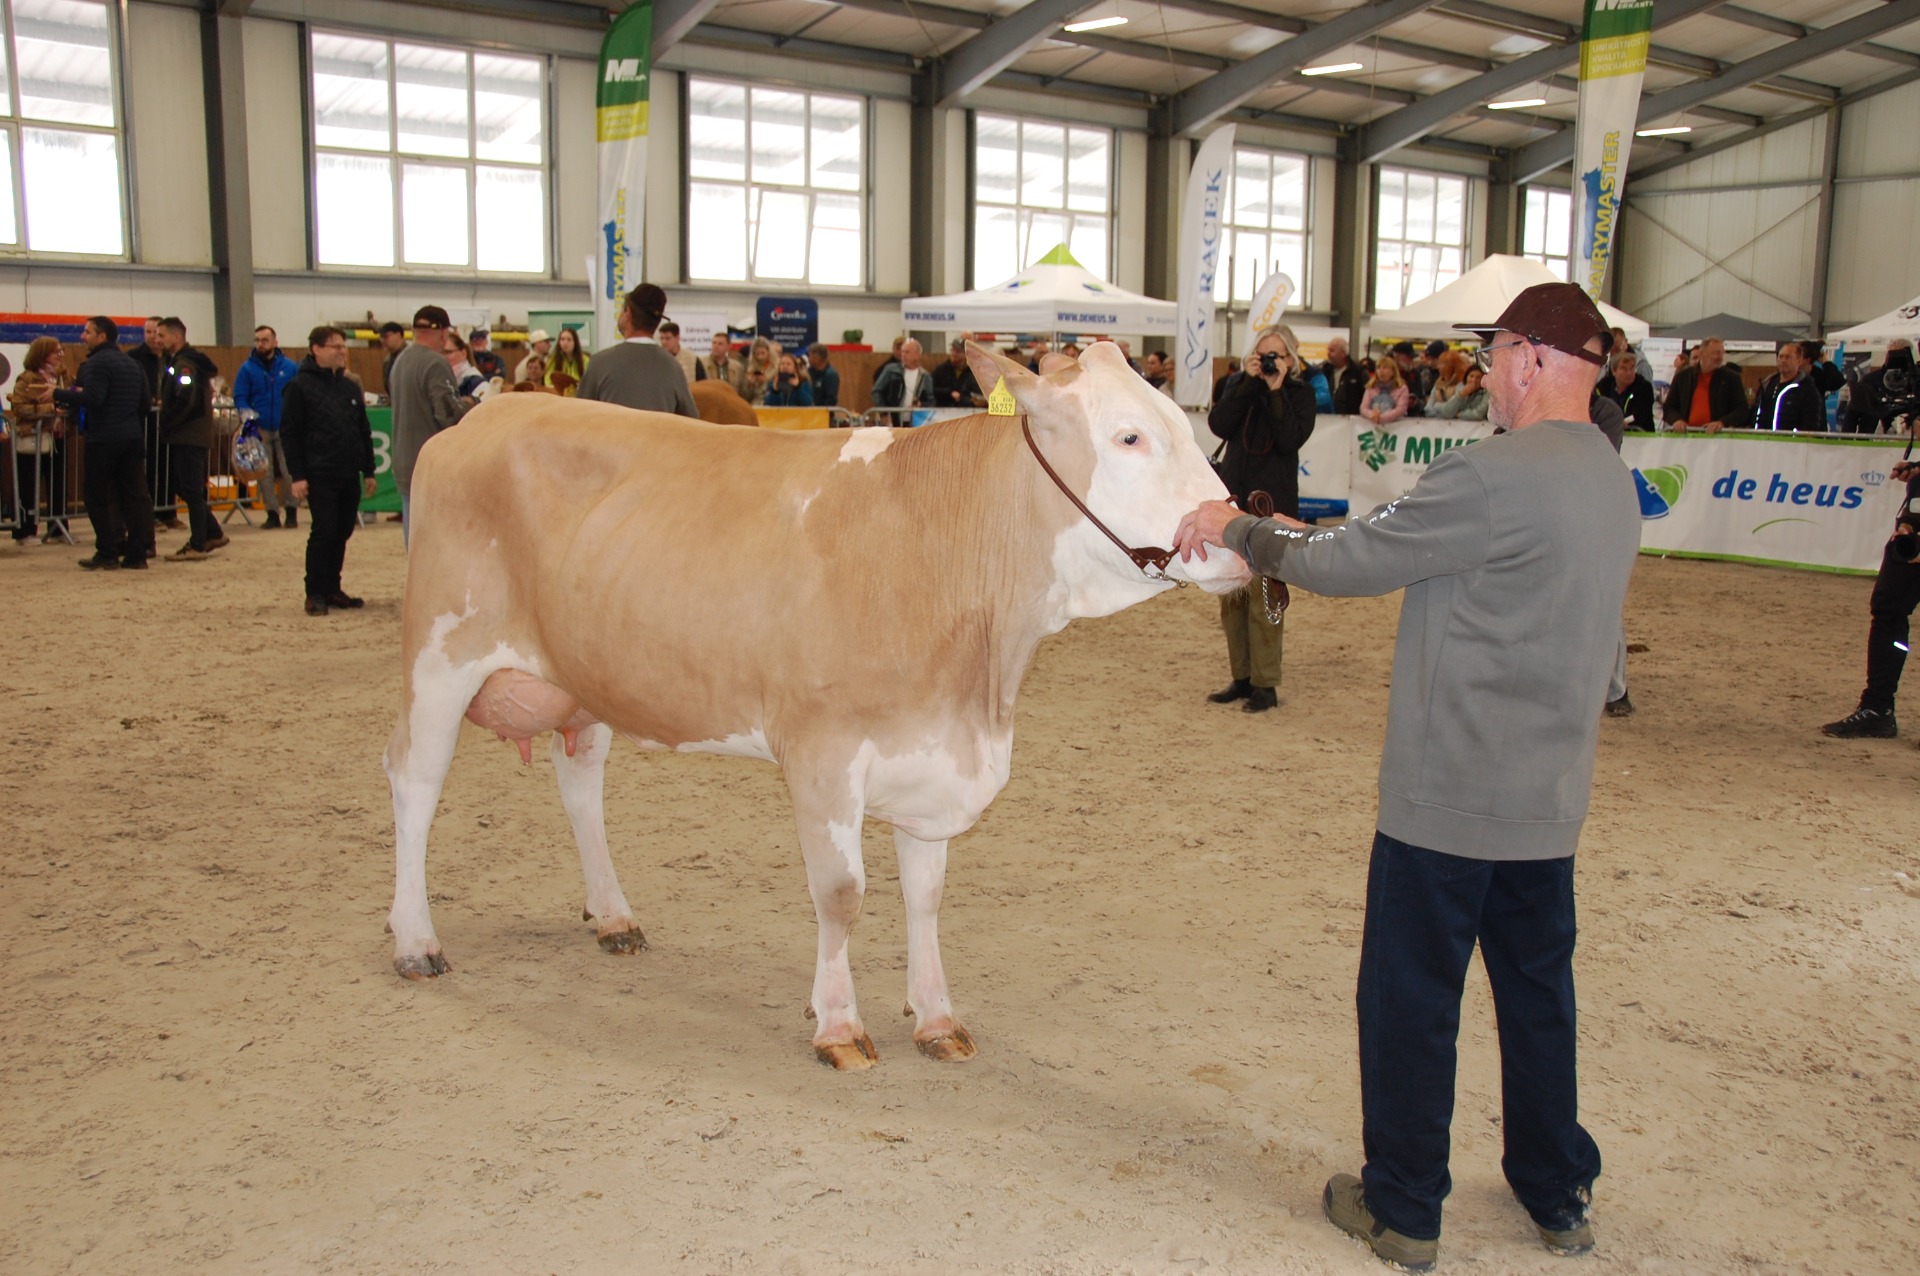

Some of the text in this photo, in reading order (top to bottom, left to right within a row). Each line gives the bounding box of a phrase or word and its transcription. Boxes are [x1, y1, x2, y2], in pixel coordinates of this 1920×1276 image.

[1200, 168, 1223, 293] RACEK
[1057, 312, 1118, 324] WWW.DEHEUS.SK
[1712, 470, 1864, 509] de heus
